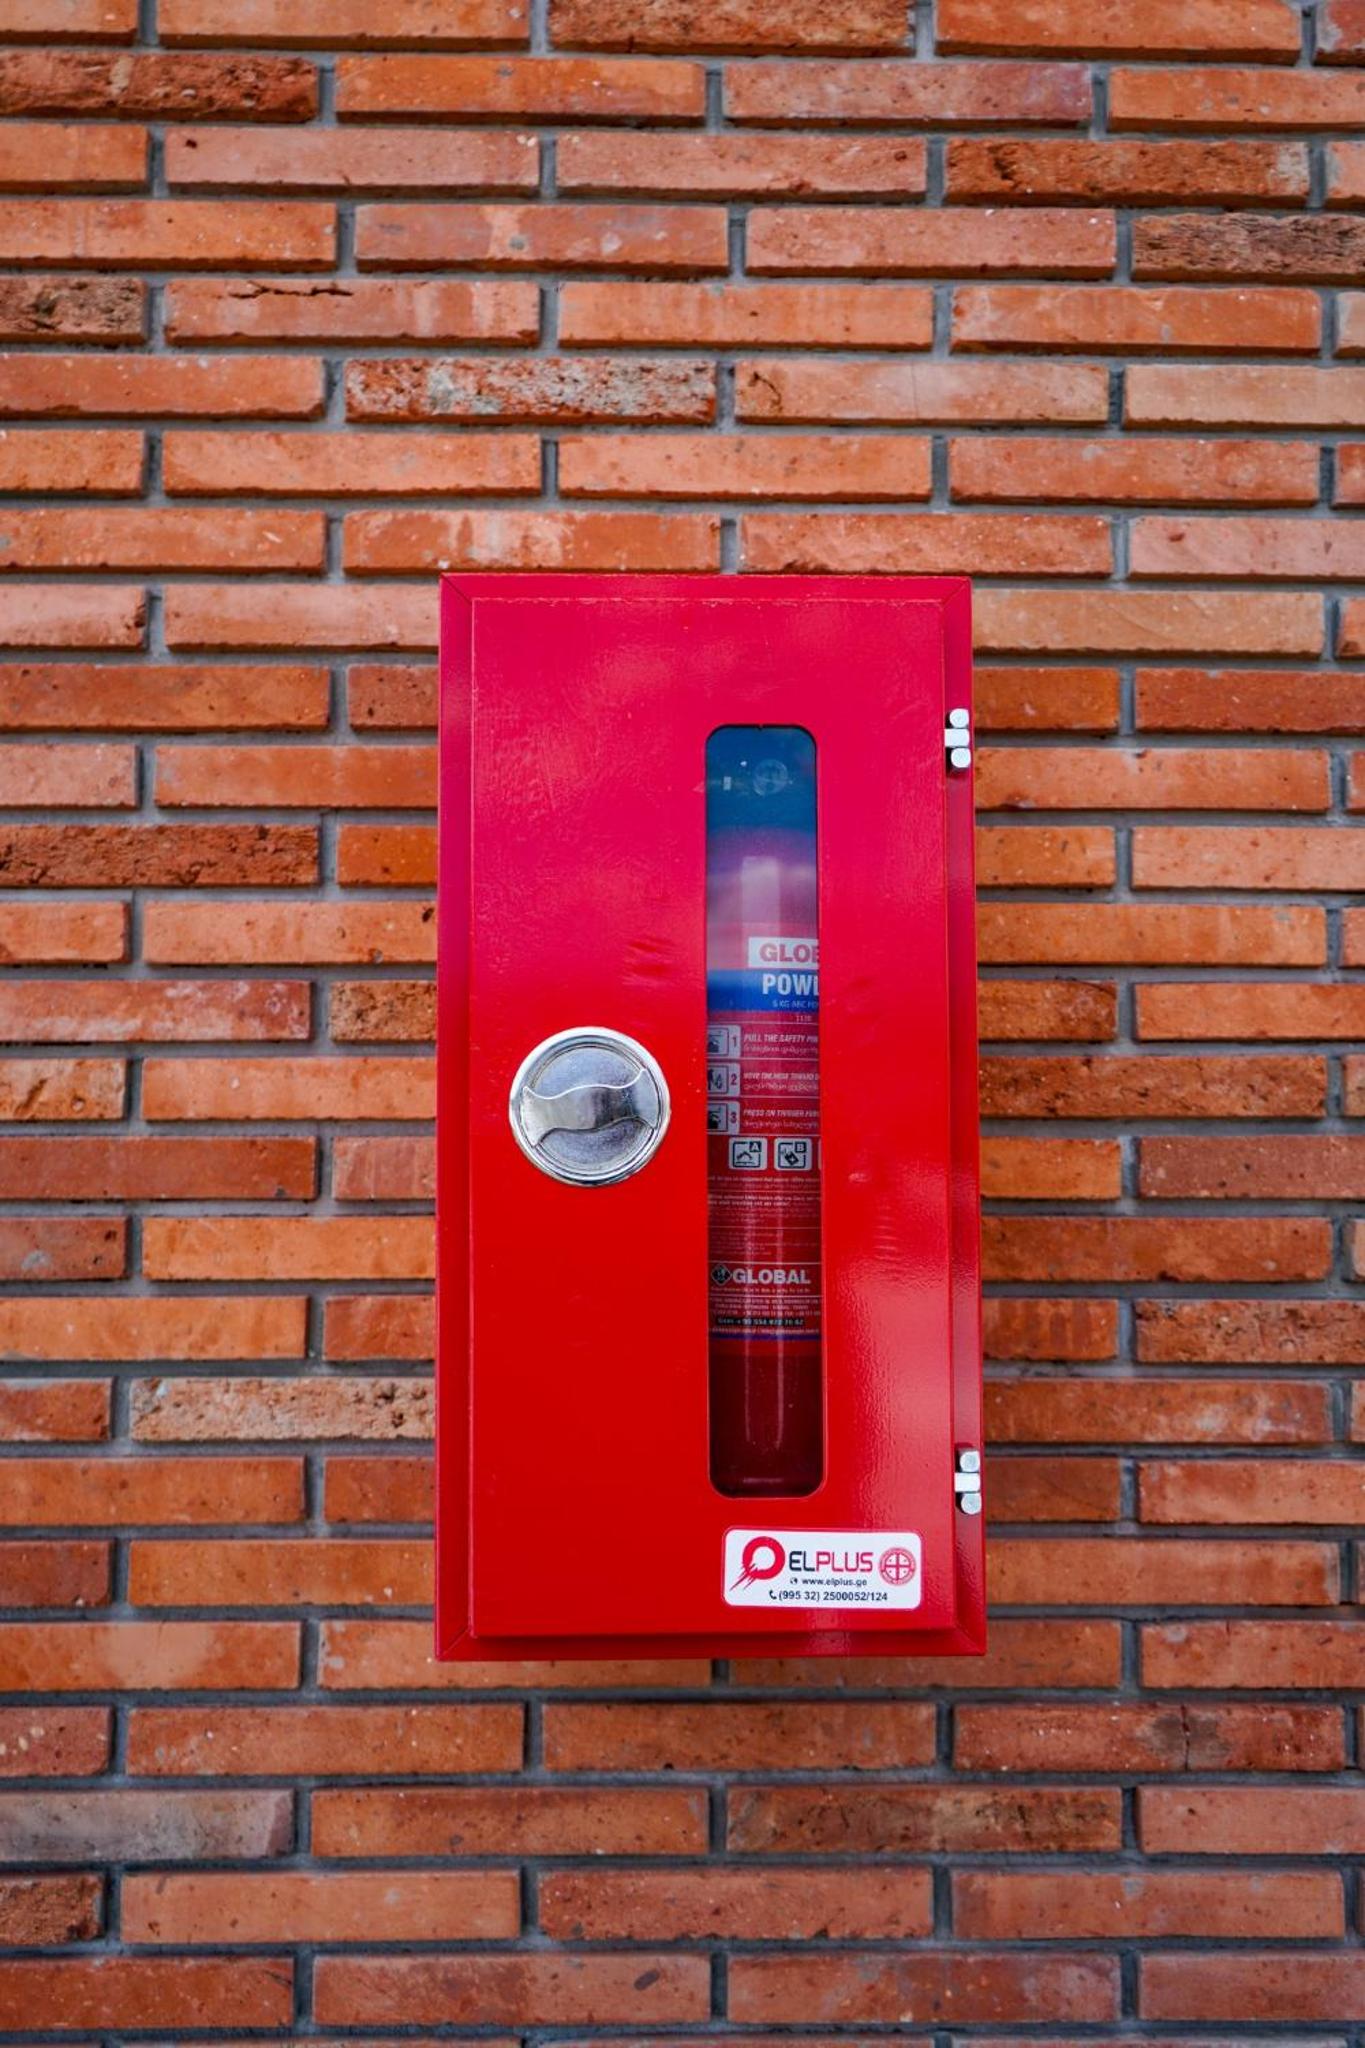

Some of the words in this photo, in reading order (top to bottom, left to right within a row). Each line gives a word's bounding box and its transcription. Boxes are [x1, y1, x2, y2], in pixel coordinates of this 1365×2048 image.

[762, 973, 819, 996] POW
[733, 1035, 737, 1047] 1
[743, 1033, 762, 1043] PULL
[763, 1034, 779, 1043] THE
[779, 1034, 806, 1043] SAFETY
[730, 1073, 738, 1086] 2
[730, 1111, 737, 1123] 3
[751, 1142, 760, 1151] A
[796, 1142, 804, 1152] B
[732, 1268, 812, 1285] GLOBAL
[788, 1550, 874, 1572] ELPLUS
[801, 1577, 868, 1588] www.elplus.ge
[778, 1589, 801, 1601] (995
[804, 1590, 820, 1601] 32)
[823, 1590, 888, 1602] 2500052/124
